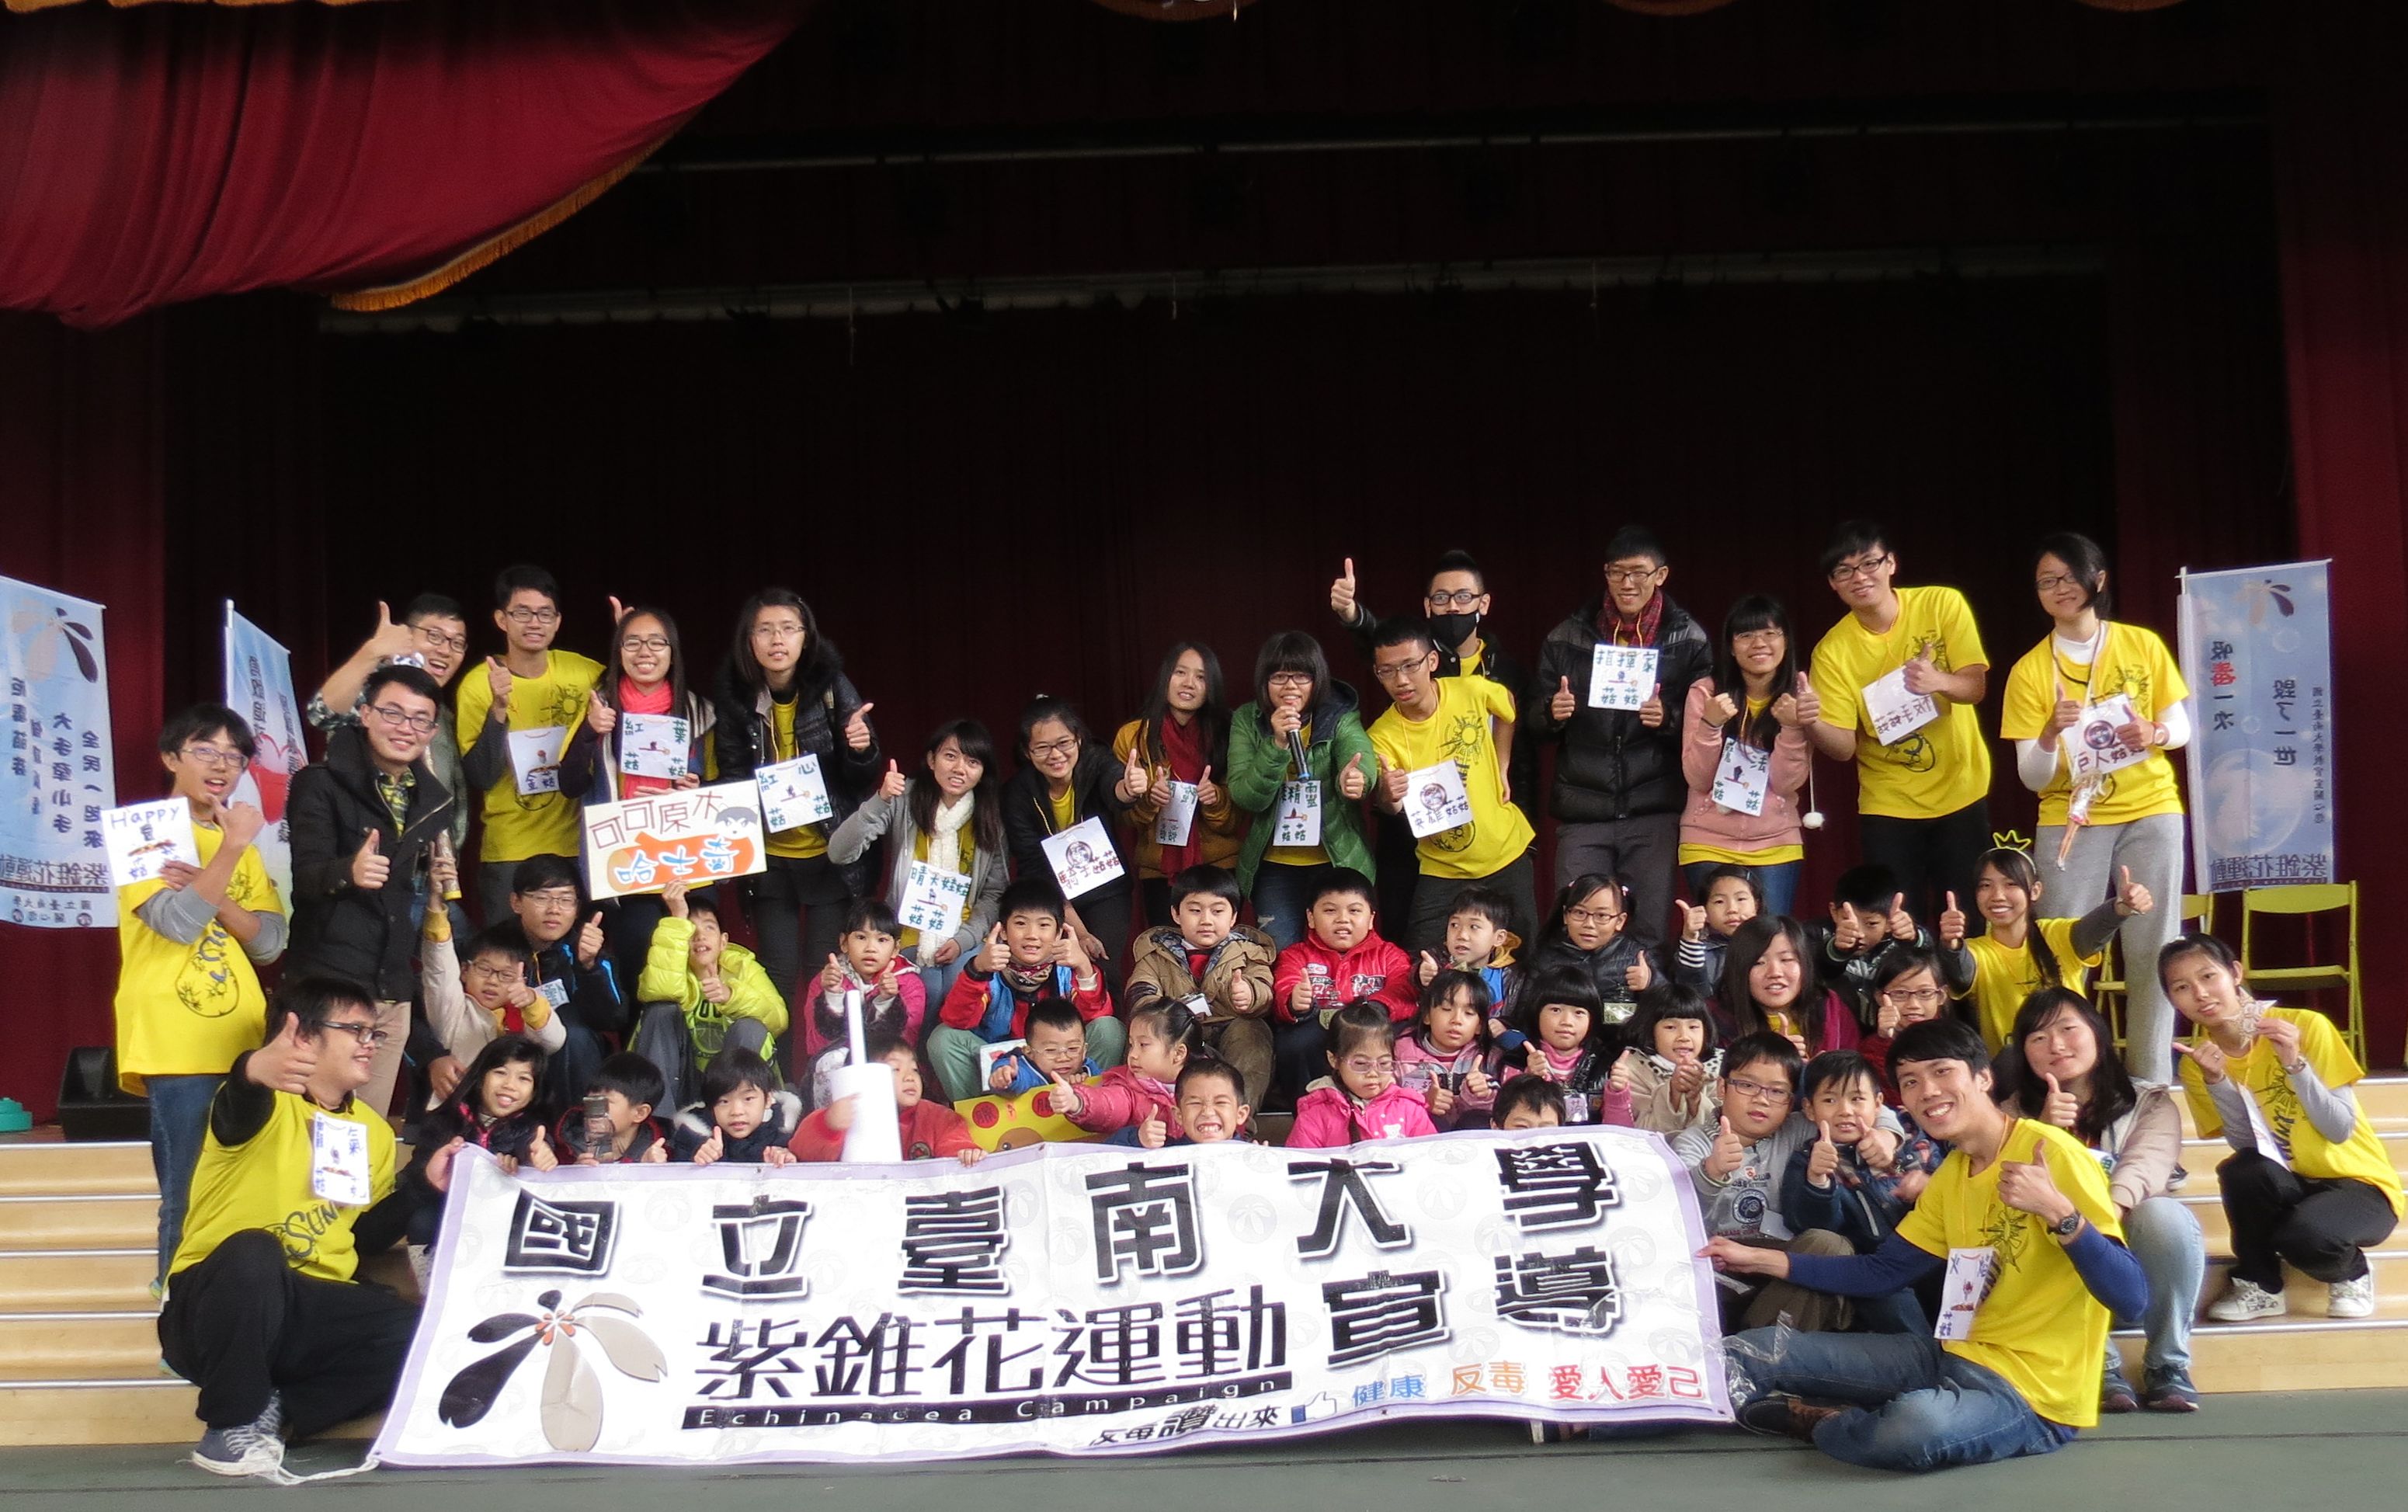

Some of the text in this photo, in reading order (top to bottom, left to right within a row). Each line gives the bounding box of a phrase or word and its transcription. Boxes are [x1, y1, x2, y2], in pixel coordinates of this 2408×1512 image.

[623, 718, 688, 744] 紅葉
[110, 806, 180, 830] Happy
[910, 864, 971, 896] 晴天娃娃
[505, 1140, 1621, 1298] 國立臺南大學
[1322, 1246, 1624, 1368] 宣導
[696, 1284, 1289, 1400] 紫錐花運動
[699, 1378, 1278, 1427] Echinacea Campaign
[1351, 1372, 1427, 1409] 健康
[1450, 1359, 1529, 1398] 反毒
[1548, 1363, 1704, 1403] 愛人愛己
